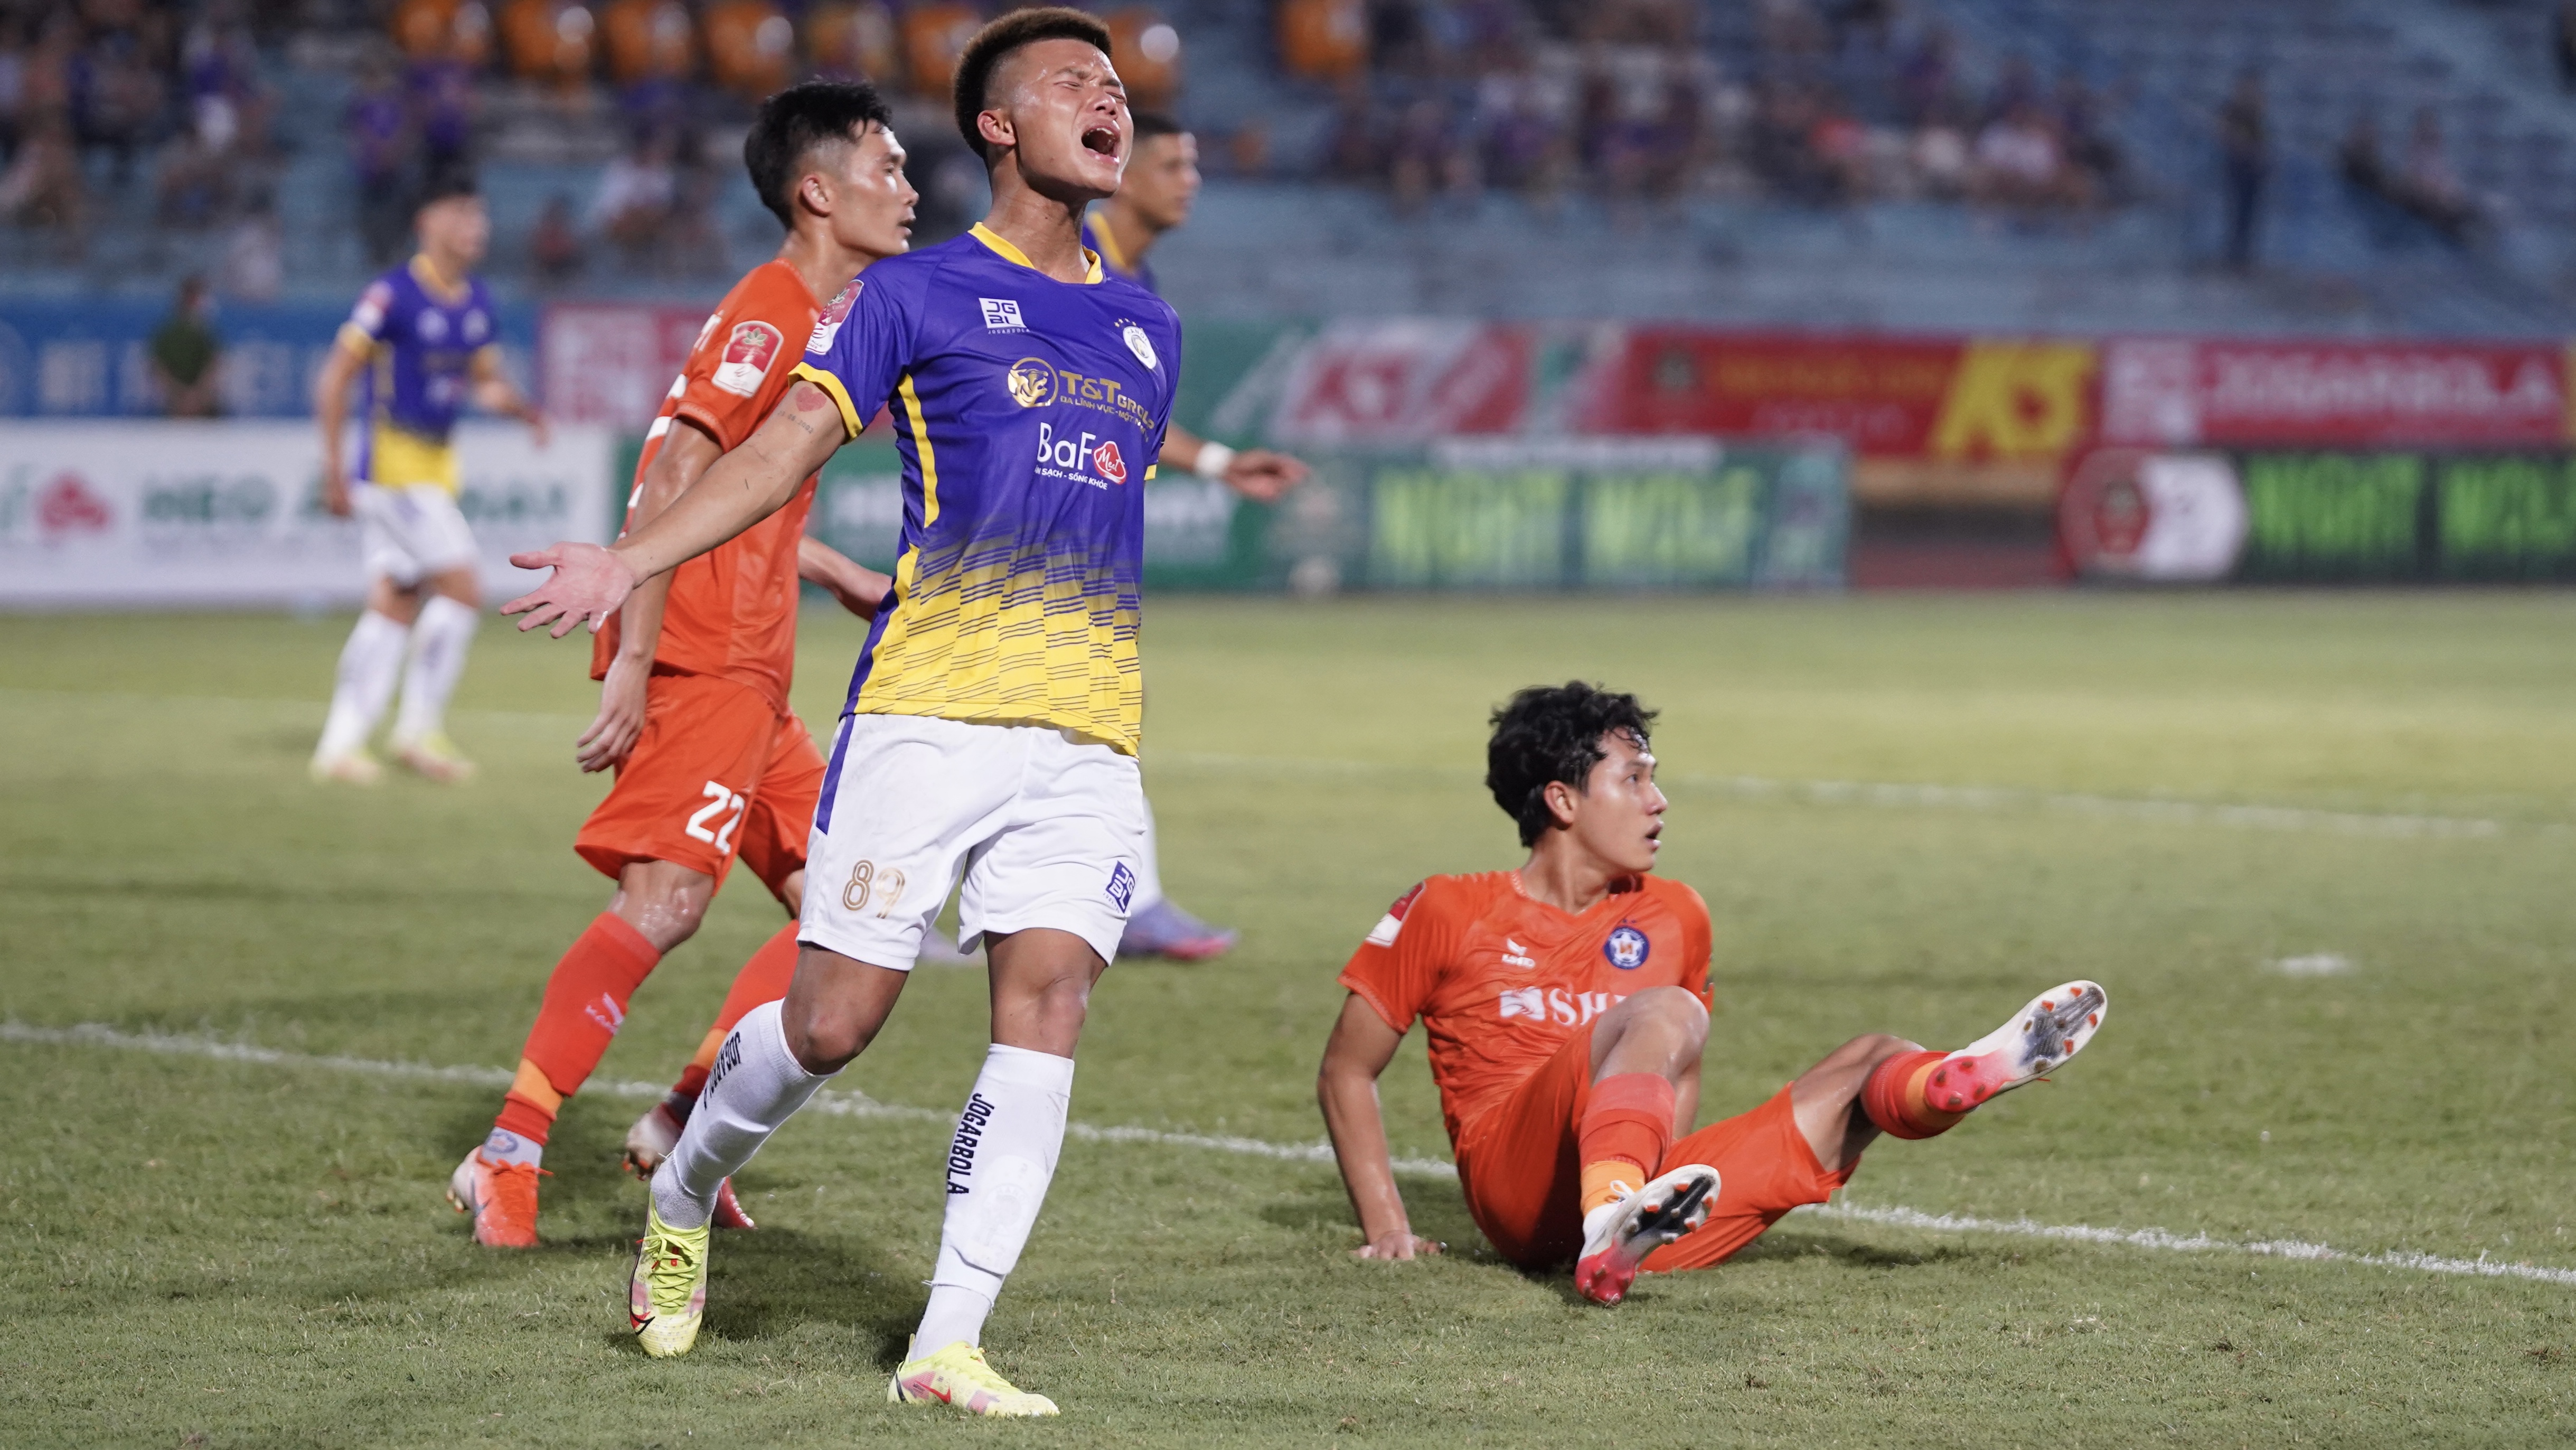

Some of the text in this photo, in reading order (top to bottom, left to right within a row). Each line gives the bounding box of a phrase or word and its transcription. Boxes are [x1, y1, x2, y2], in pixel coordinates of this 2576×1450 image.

[1059, 370, 1121, 404] T&T
[1037, 422, 1096, 470] BaF
[1041, 468, 1063, 478] SẠCH
[842, 859, 905, 919] 89
[1549, 988, 1627, 1026] SH
[947, 1092, 995, 1194] JOGARBOLA
